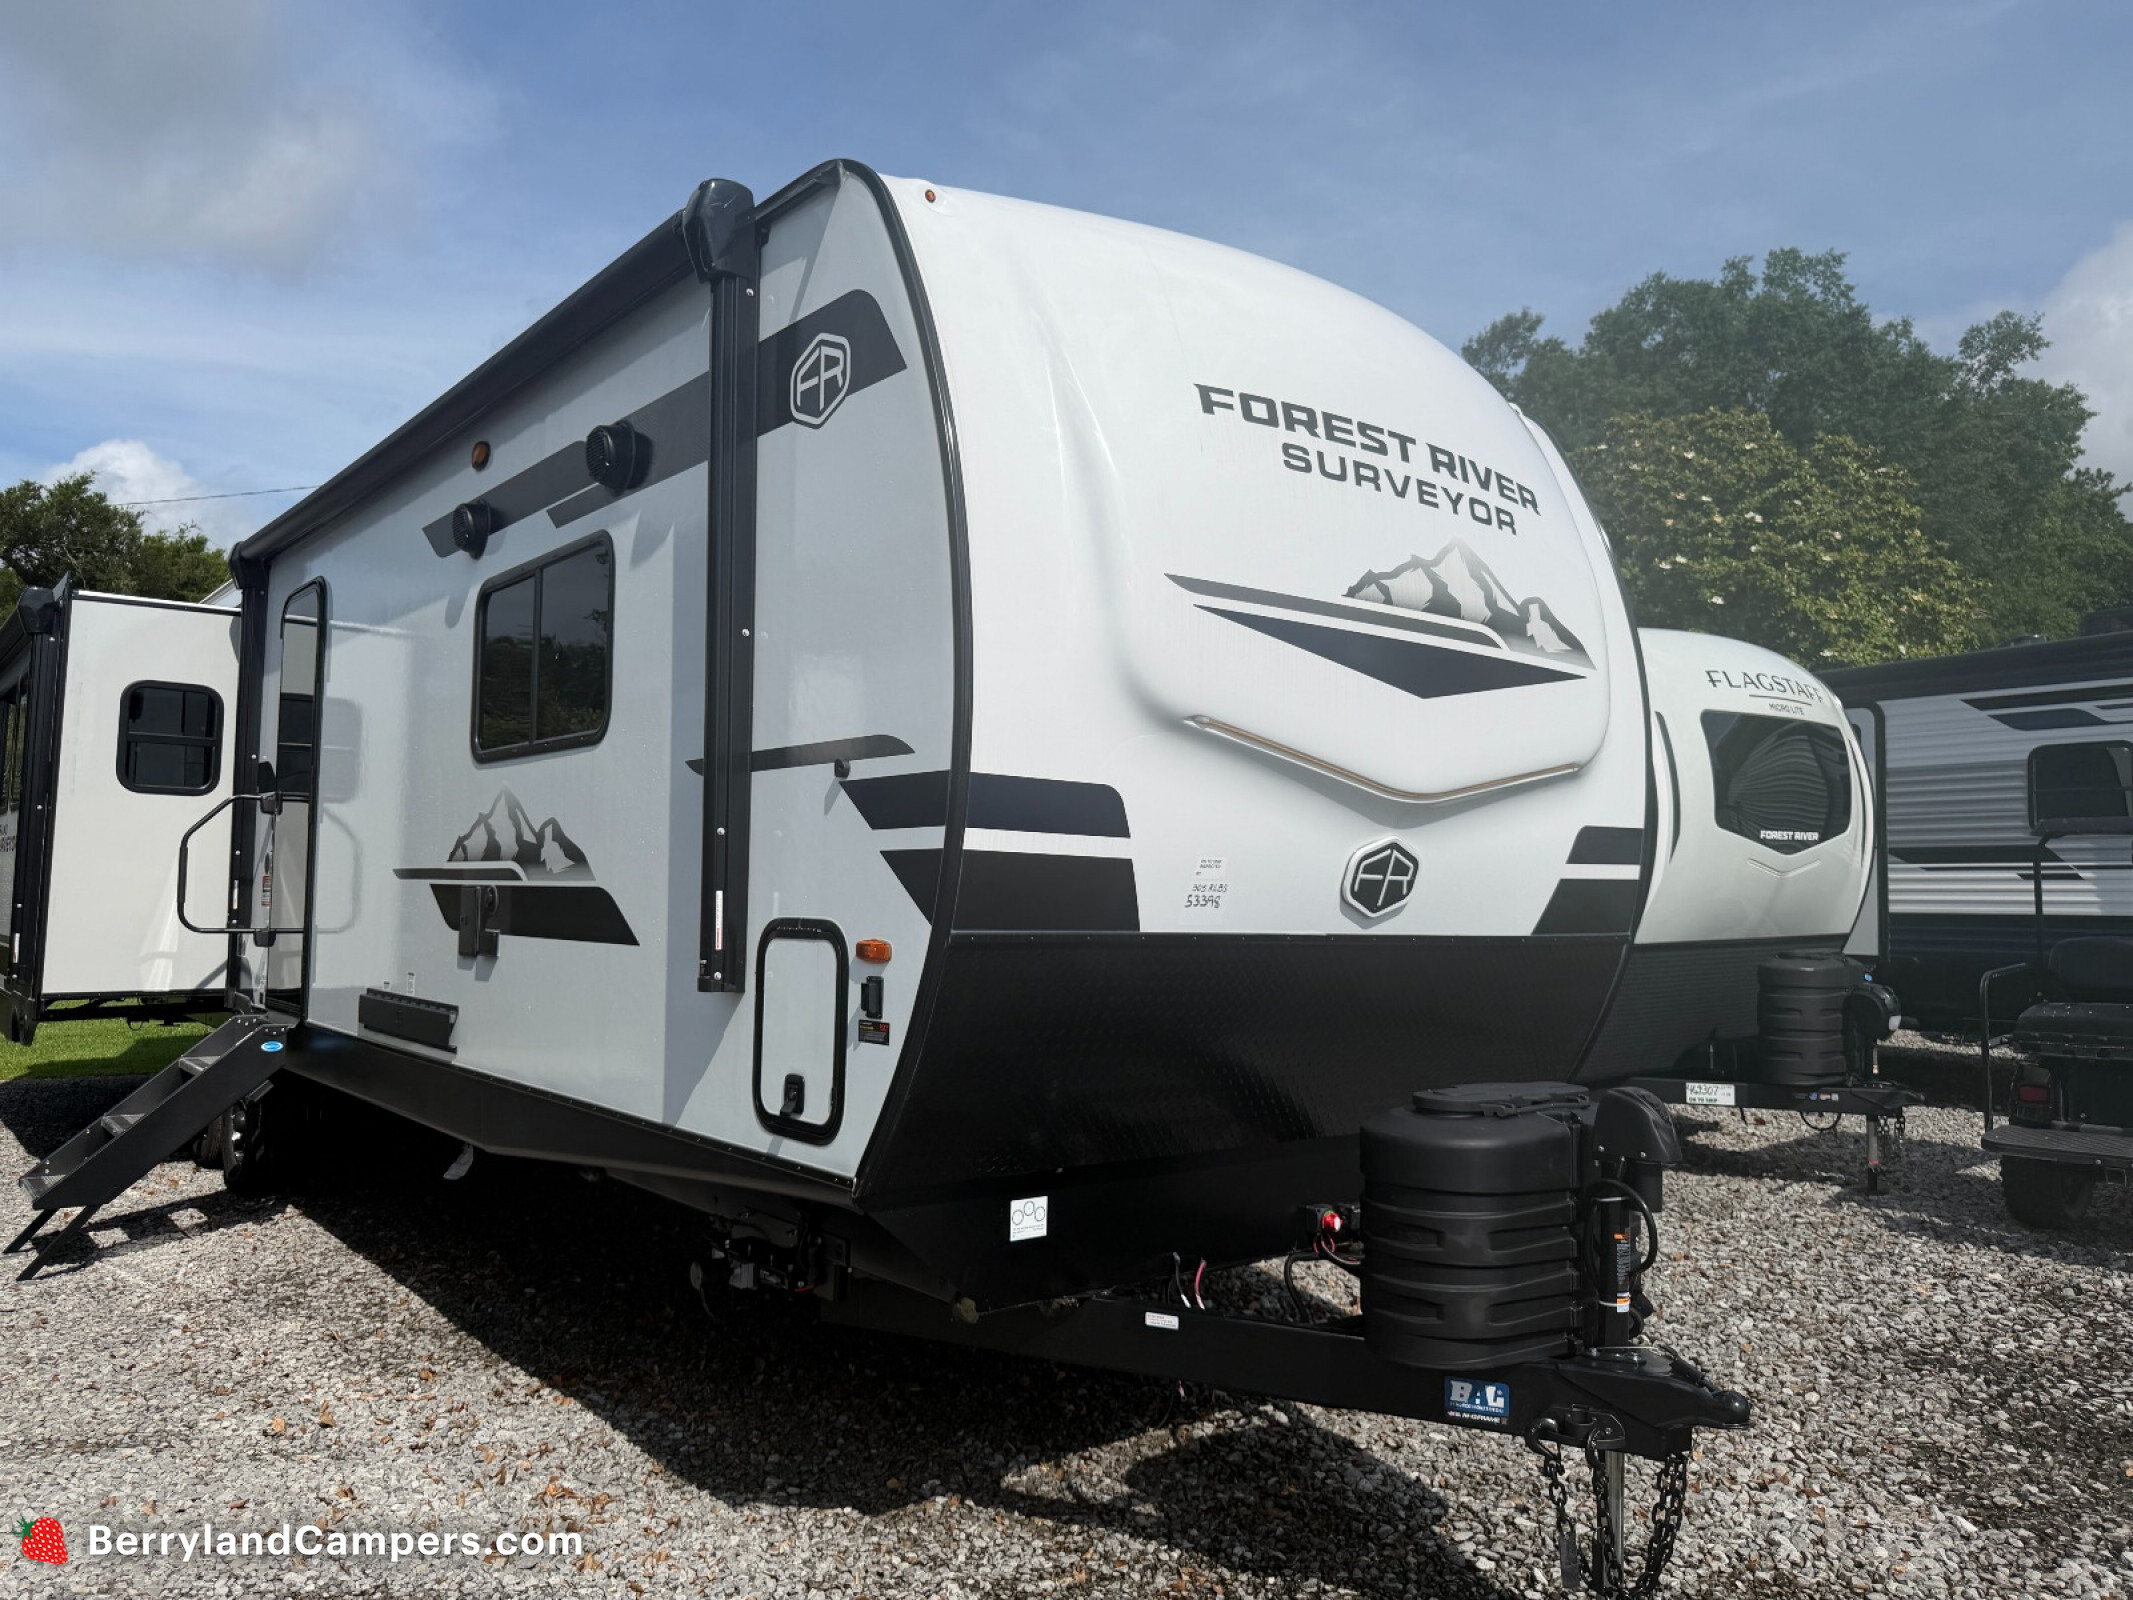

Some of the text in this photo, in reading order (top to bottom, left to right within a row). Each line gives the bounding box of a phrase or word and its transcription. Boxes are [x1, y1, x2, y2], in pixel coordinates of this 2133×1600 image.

[1193, 383, 1541, 516] FOREST RIVER
[1282, 442, 1517, 535] SURVEYOR
[1705, 670, 1822, 703] FLAGSTAFF
[1768, 703, 1805, 715] MICRO LITE
[1760, 830, 1819, 841] FOREST RIVER
[1184, 894, 1221, 909] 53398
